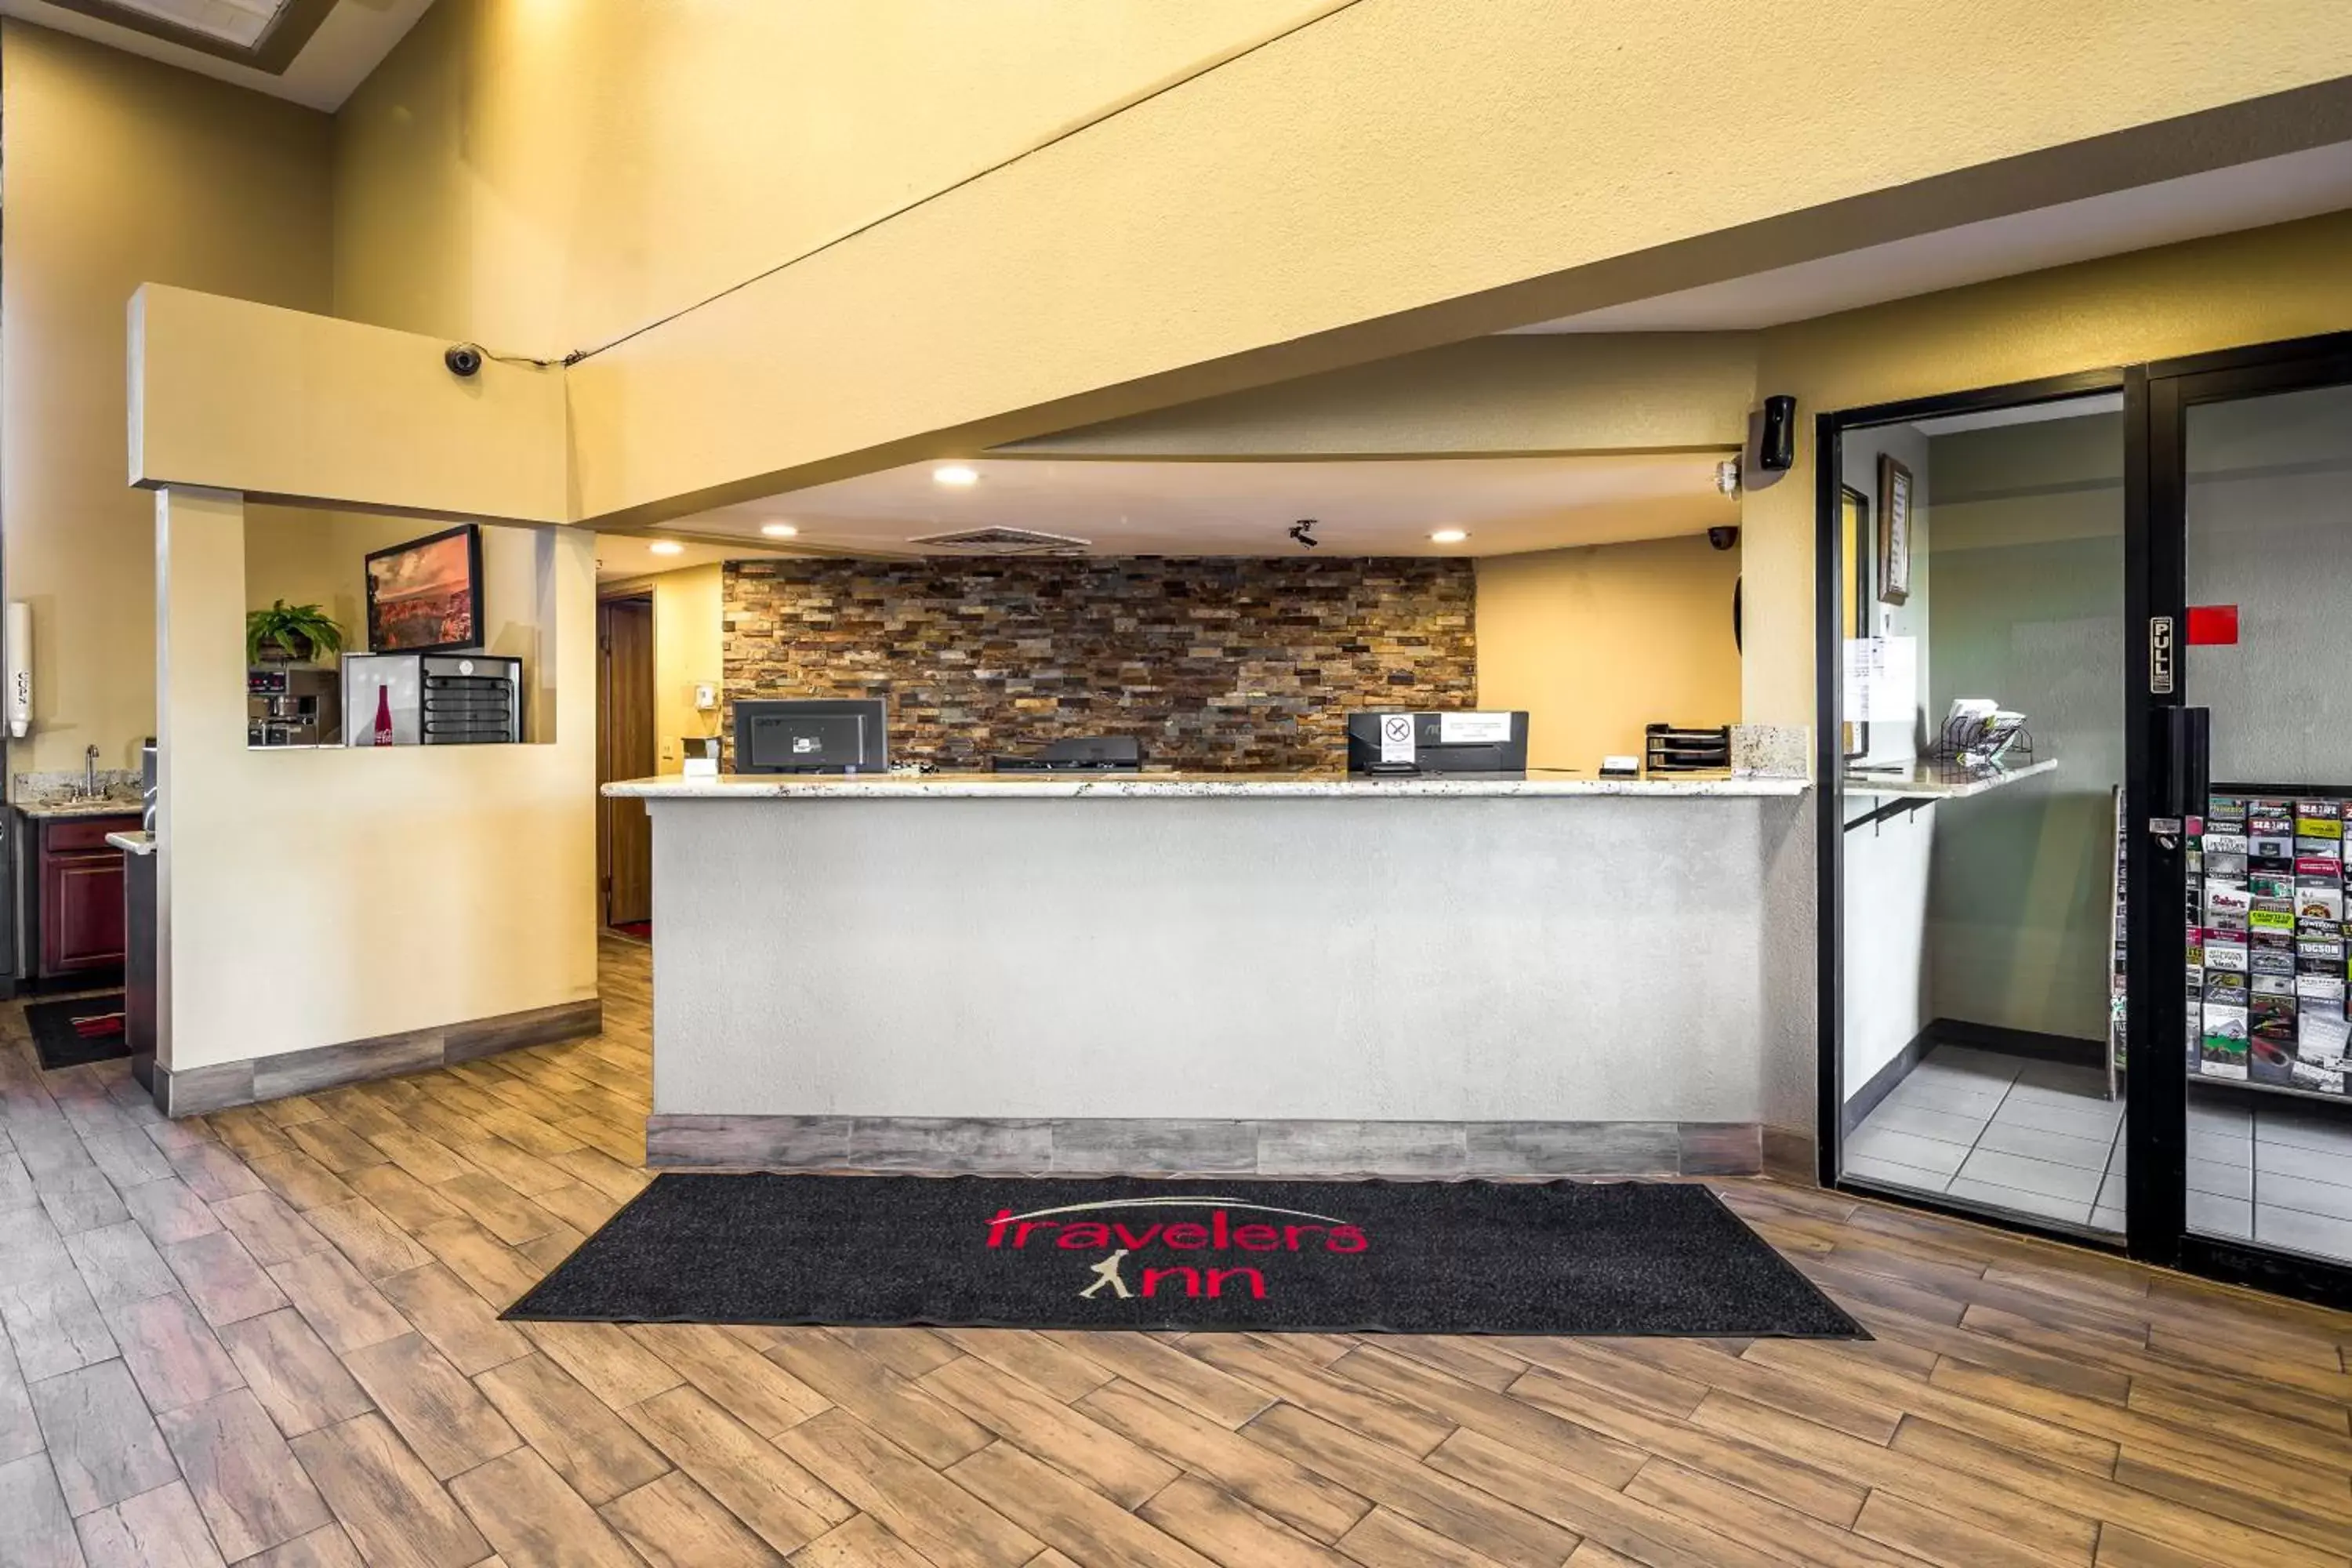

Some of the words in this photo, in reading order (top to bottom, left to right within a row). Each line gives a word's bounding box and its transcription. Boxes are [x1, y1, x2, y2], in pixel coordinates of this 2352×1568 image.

[2154, 624, 2169, 674] PULL
[2299, 943, 2339, 954] TUCSON
[985, 1209, 1368, 1252] travelers
